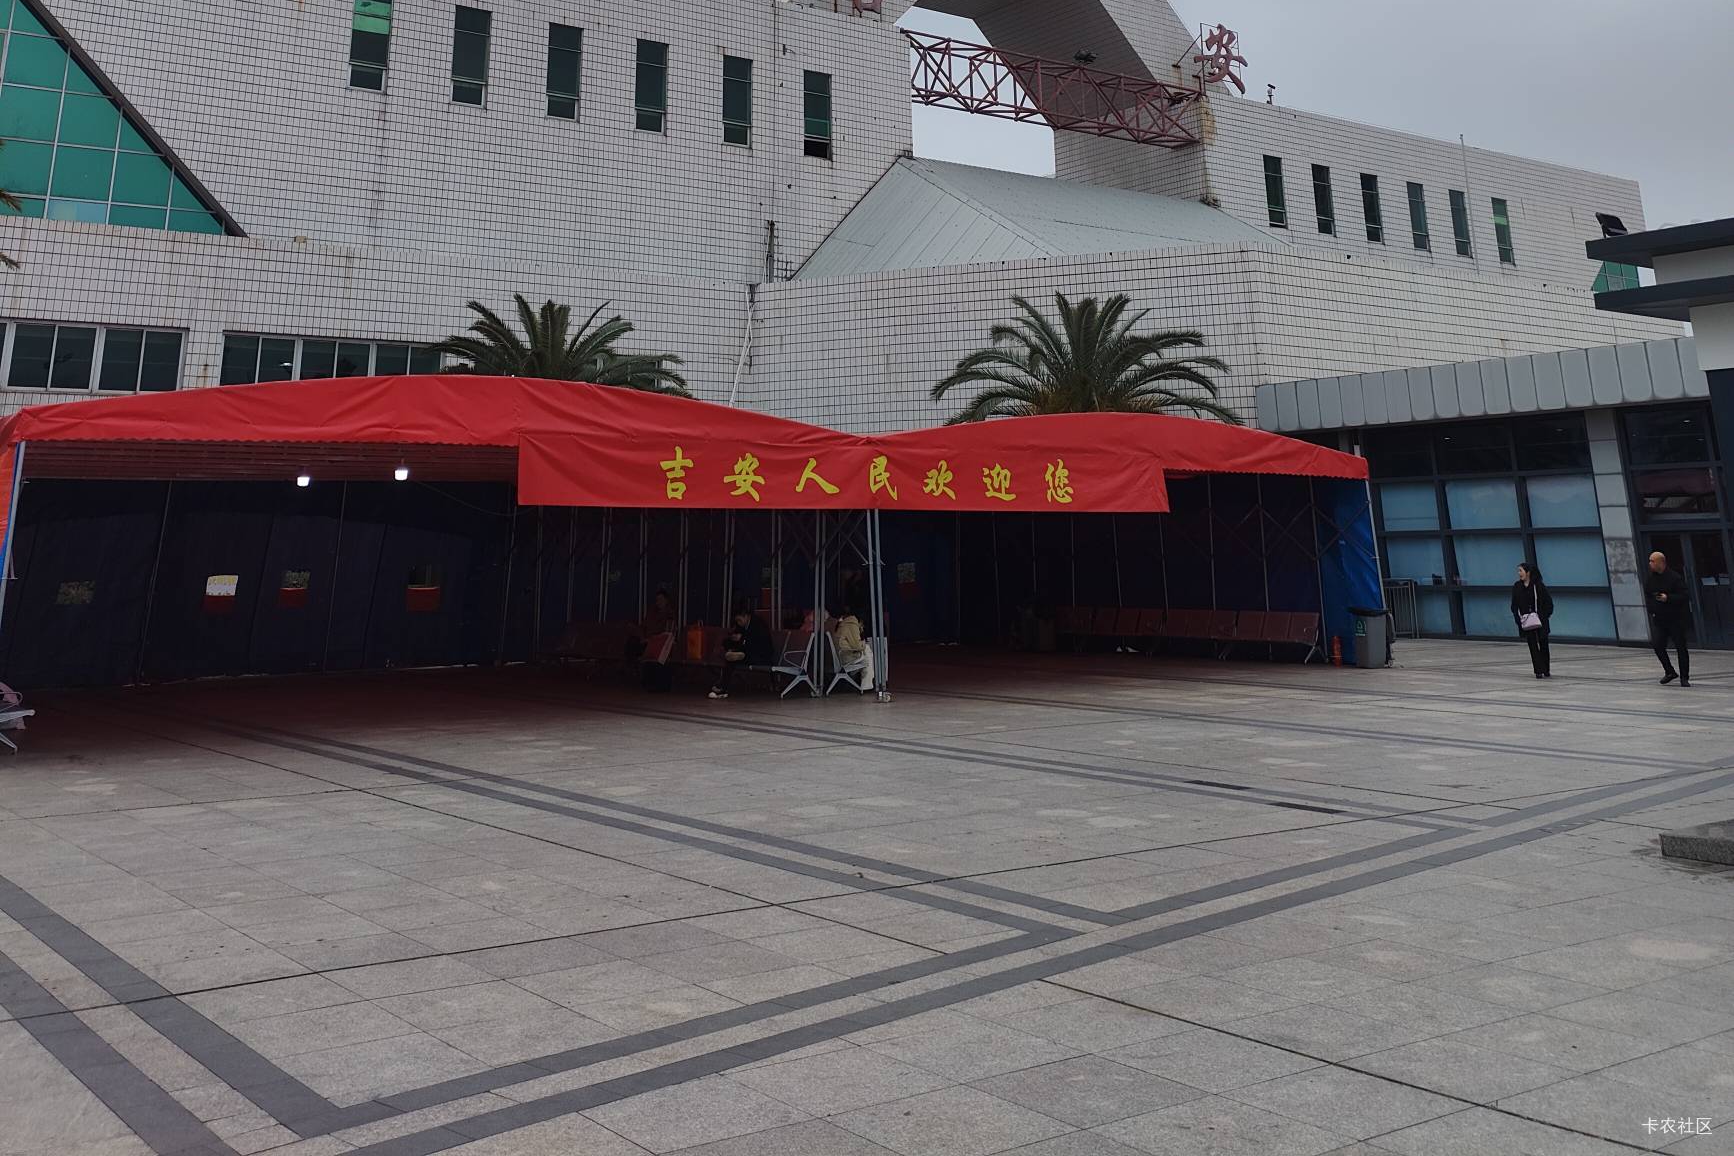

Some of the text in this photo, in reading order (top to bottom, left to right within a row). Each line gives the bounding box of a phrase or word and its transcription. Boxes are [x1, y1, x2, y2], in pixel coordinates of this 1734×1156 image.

[1193, 23, 1249, 94] 安
[660, 446, 1073, 503] 吉安人民欢迎您
